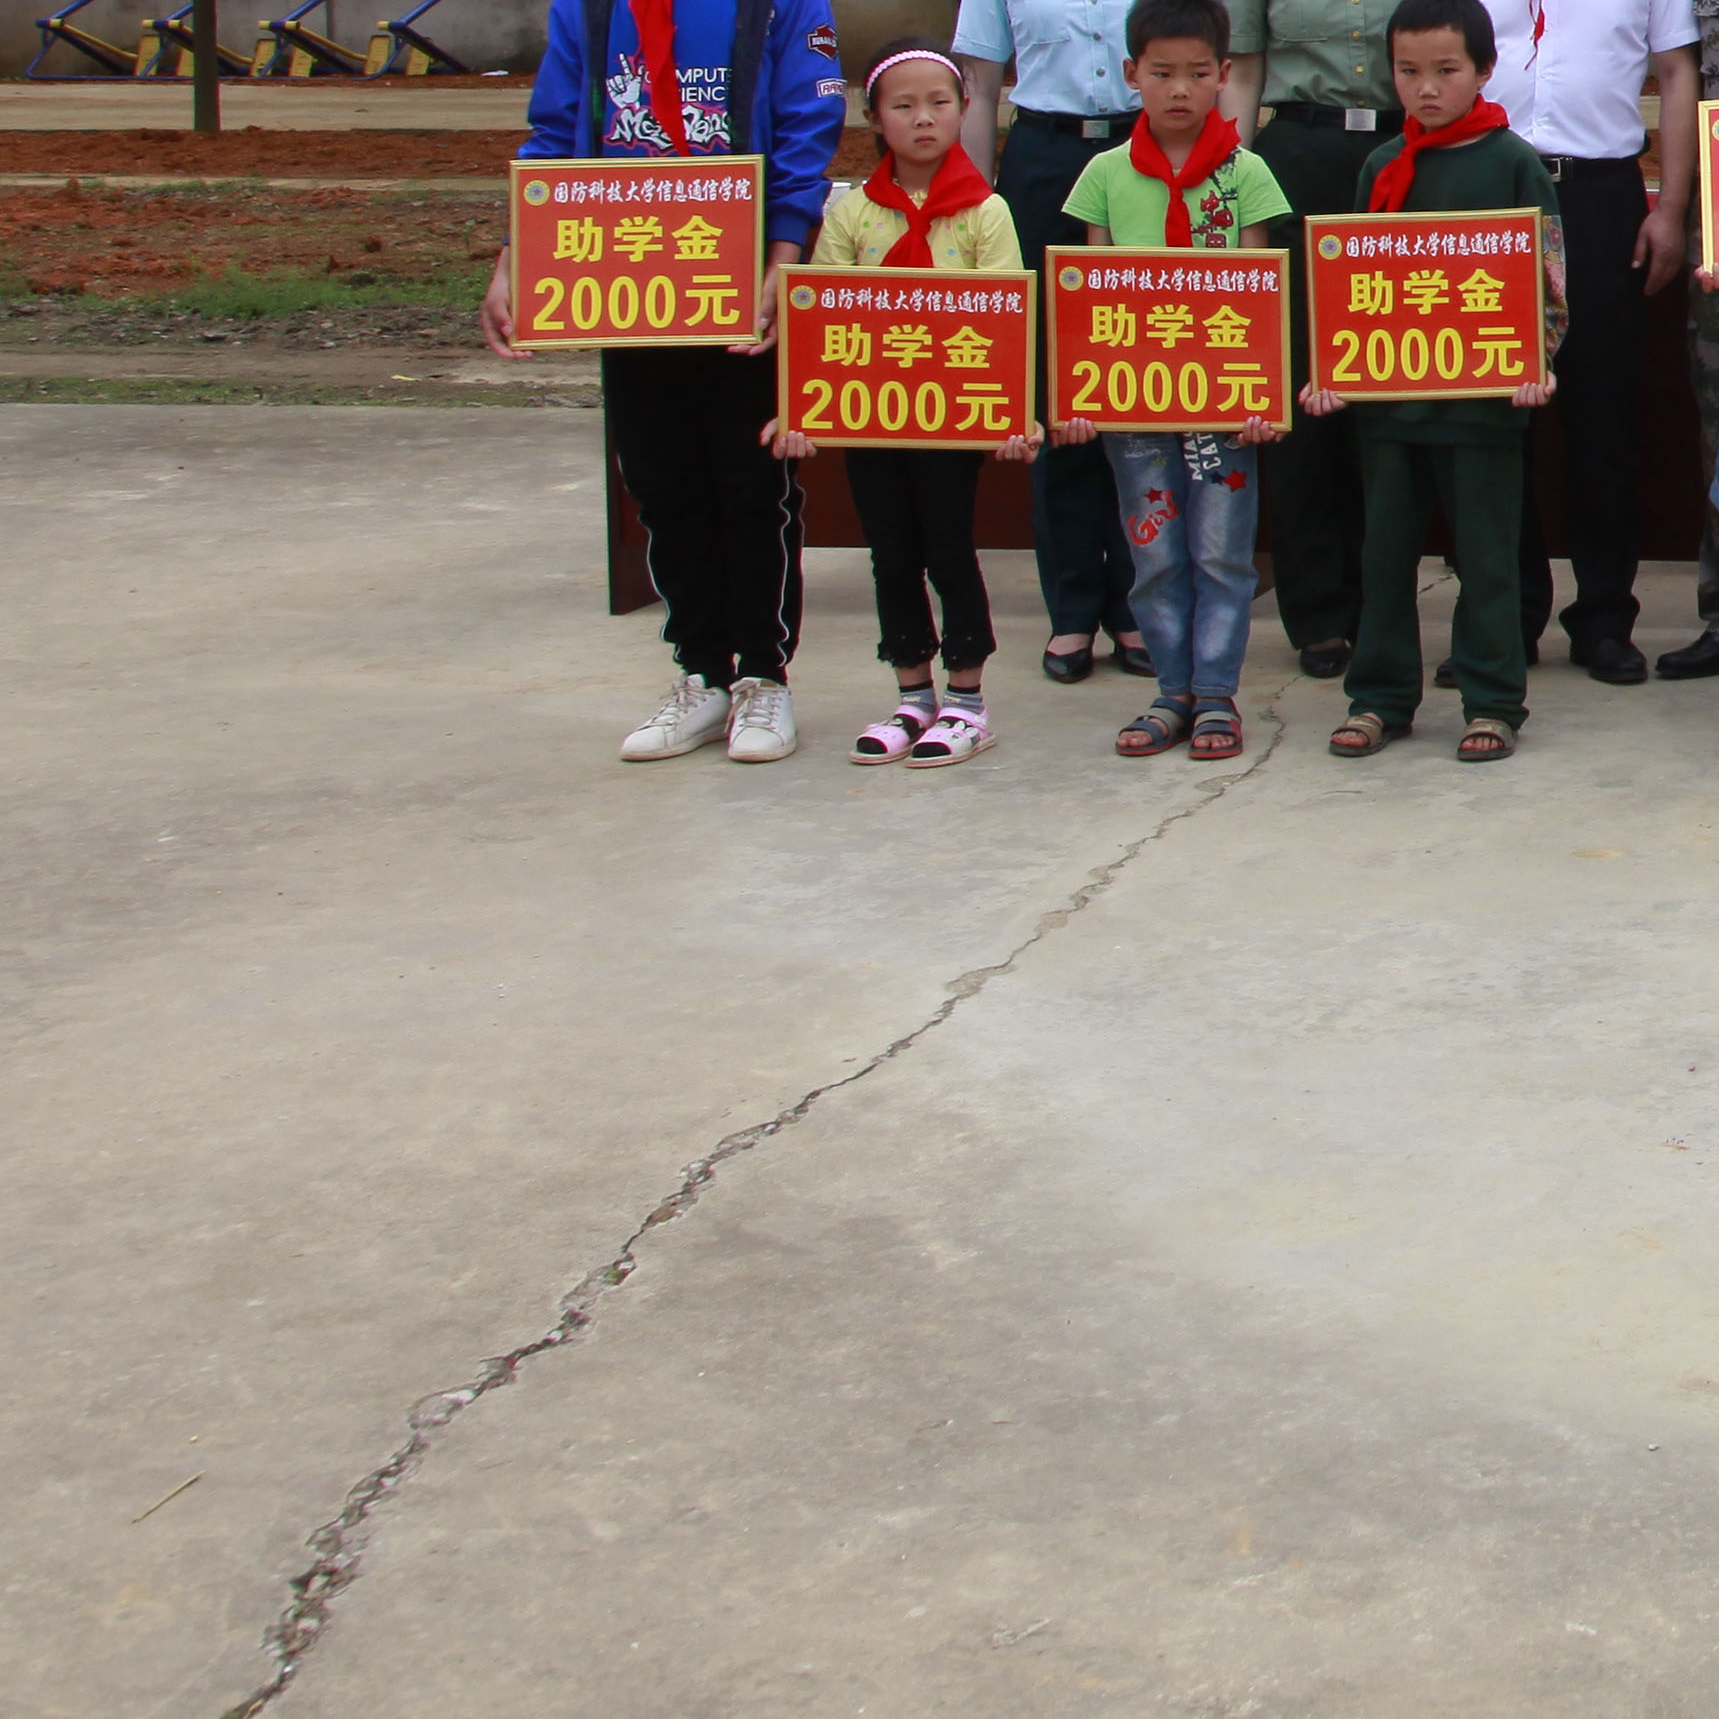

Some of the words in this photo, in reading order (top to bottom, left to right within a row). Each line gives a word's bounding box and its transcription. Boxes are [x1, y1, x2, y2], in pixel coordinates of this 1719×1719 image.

[553, 176, 753, 204] 国防科技大学信息通信学院
[552, 215, 724, 263] 助学金
[1346, 229, 1532, 258] 国防科技大学信息通信学院
[532, 274, 741, 331] 2000元
[821, 287, 1023, 314] 国防科技大学信息通信学院
[1087, 267, 1279, 293] 国防科技大学信息通信学院
[1347, 268, 1505, 316] 助学金
[820, 323, 994, 368] 助学金
[1088, 303, 1252, 349] 助学金
[1332, 326, 1525, 382] 2000元
[801, 379, 1011, 432] 2000元
[1072, 360, 1270, 413] 2000元
